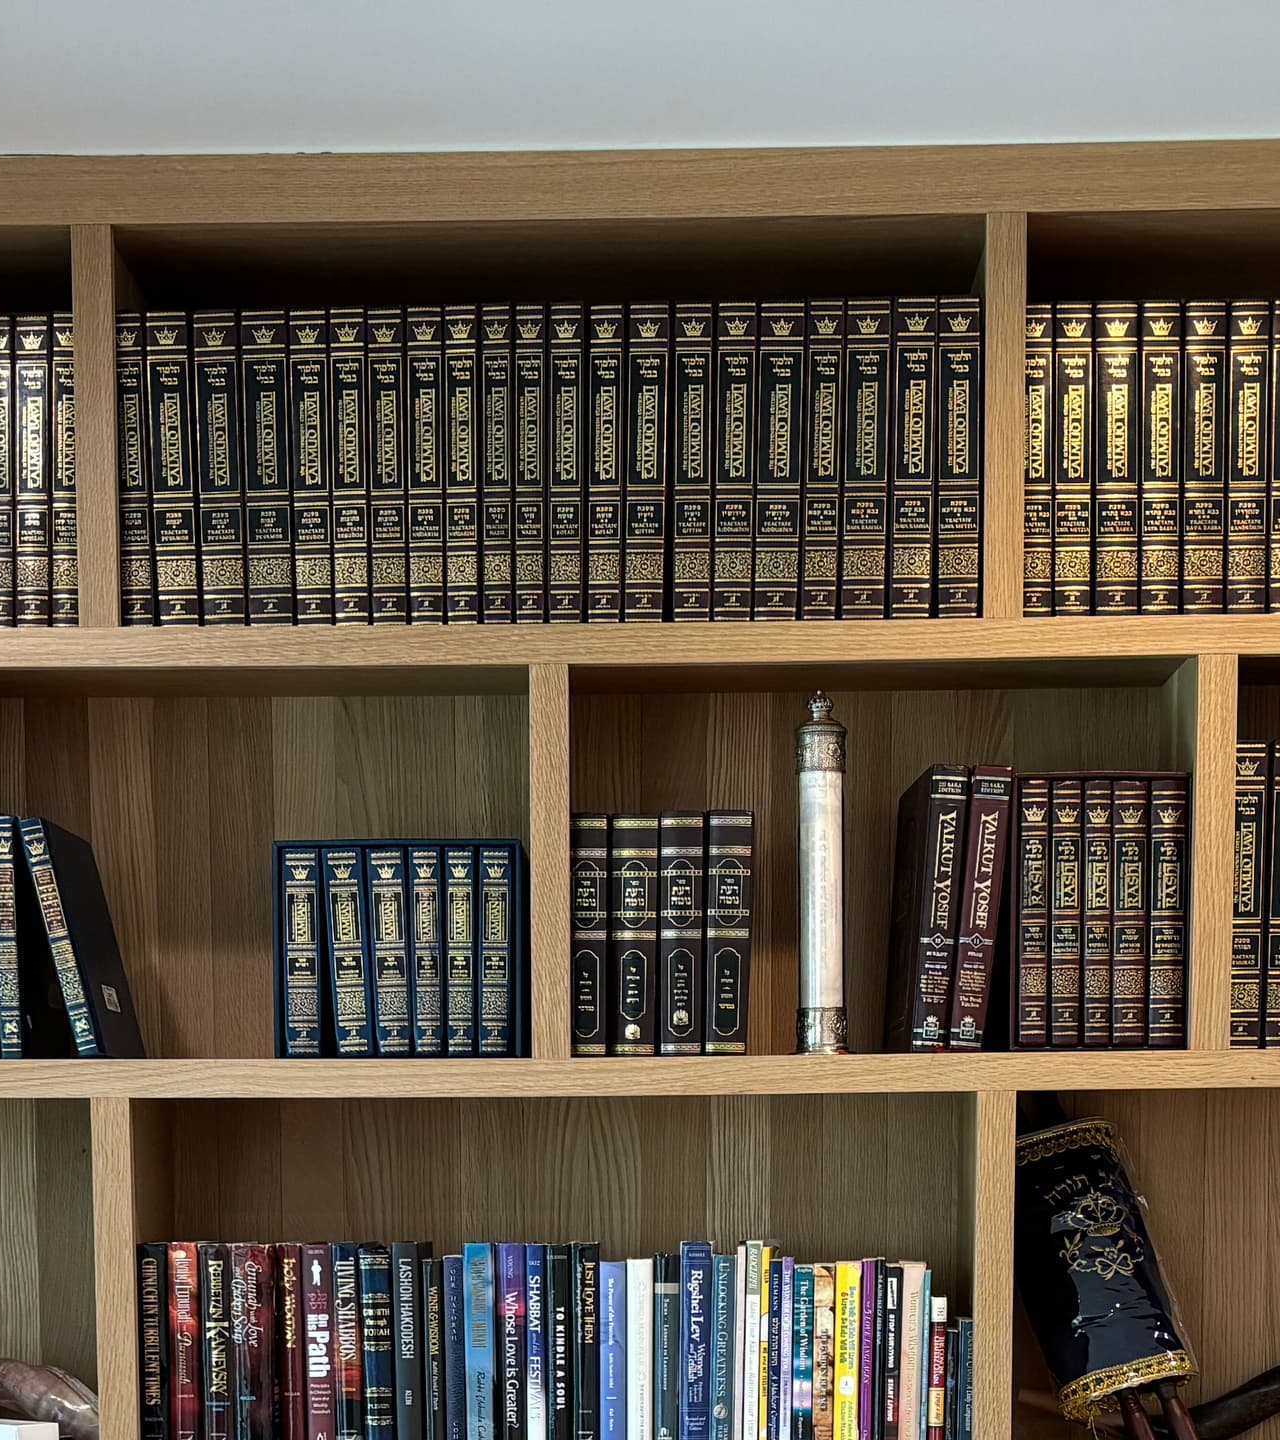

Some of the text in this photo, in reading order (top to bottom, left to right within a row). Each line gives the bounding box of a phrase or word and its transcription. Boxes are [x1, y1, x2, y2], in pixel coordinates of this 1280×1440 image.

[672, 886, 690, 895] דעת
[934, 810, 957, 930] YALKUT YOSEF
[973, 811, 999, 929] YALKUT YOSEF
[142, 1258, 157, 1299] CHINUCH
[336, 1258, 356, 1361] LIVING SHABBOS
[399, 1258, 415, 1359] LASHON HAKODESH
[529, 1275, 541, 1333] SHABBAT
[582, 1259, 596, 1344] JUST LOVE THEM
[688, 1270, 705, 1341] Rigshei Lev
[144, 1315, 160, 1372] TURBULENT
[307, 1331, 330, 1378] Path
[505, 1291, 520, 1429] Whose Love is Greater?
[556, 1307, 565, 1410] TO KINDLE A SOUL
[696, 1344, 705, 1376] Women
[717, 1262, 729, 1397] UNLOCKING GREATNESS
[145, 1375, 160, 1406] TIMES
